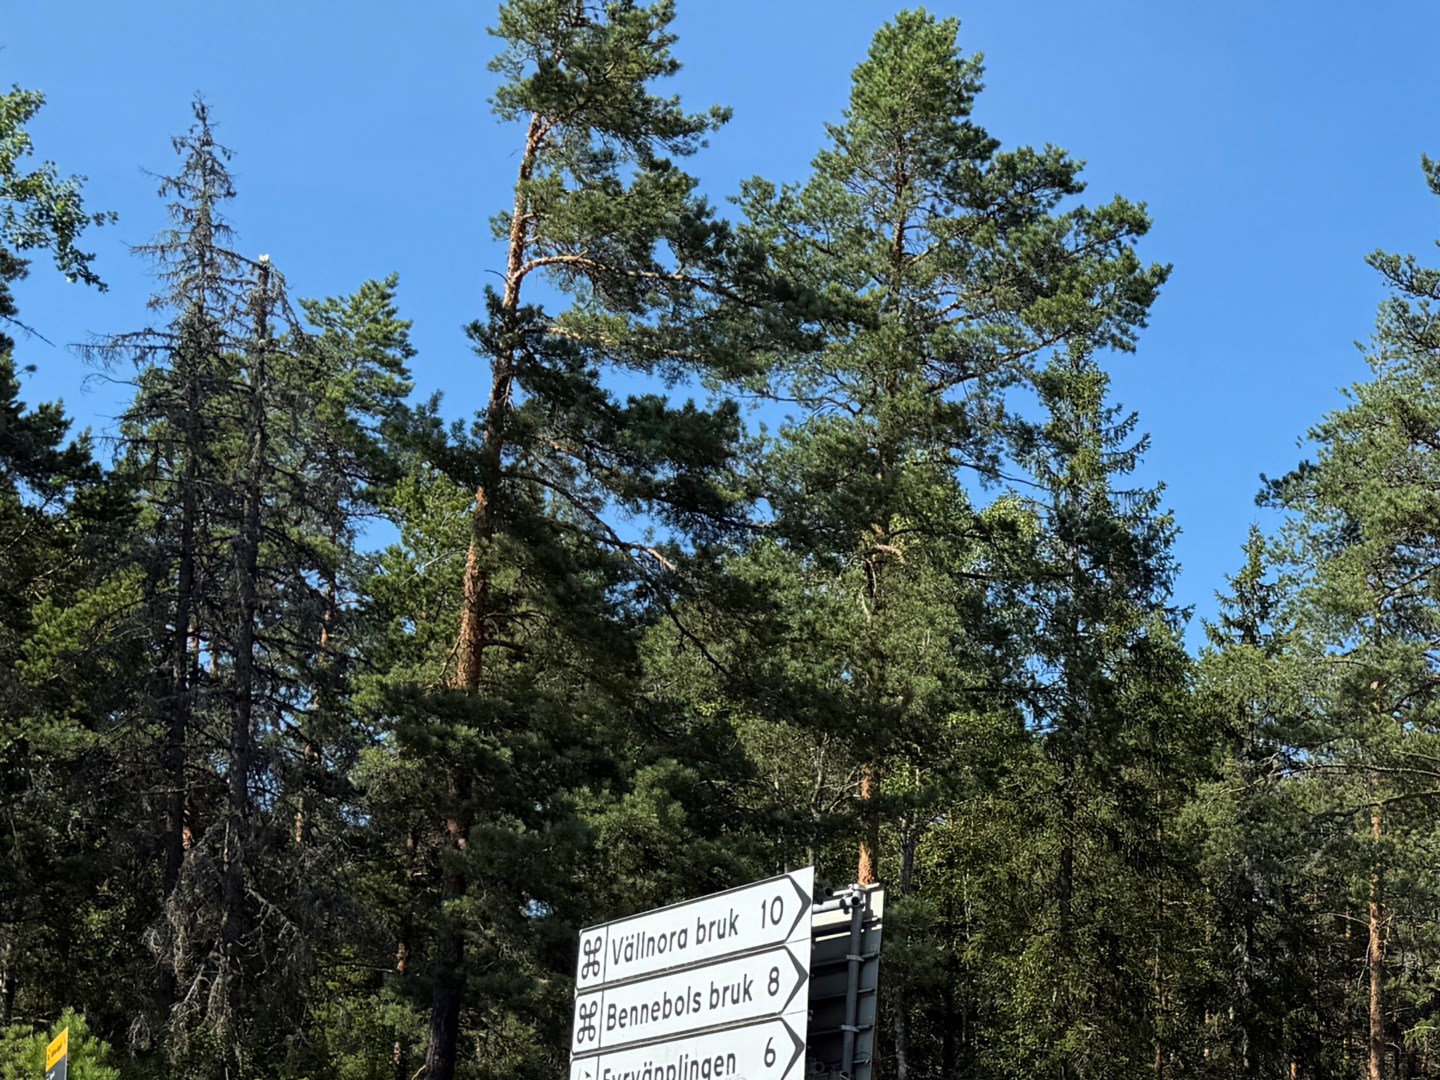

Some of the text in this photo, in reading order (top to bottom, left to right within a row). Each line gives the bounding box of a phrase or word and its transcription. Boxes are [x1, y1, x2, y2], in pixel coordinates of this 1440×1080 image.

[611, 895, 784, 966] Vällnora bruk 10
[606, 965, 780, 1032] Bennebols bruk 8
[763, 1036, 776, 1068] 6
